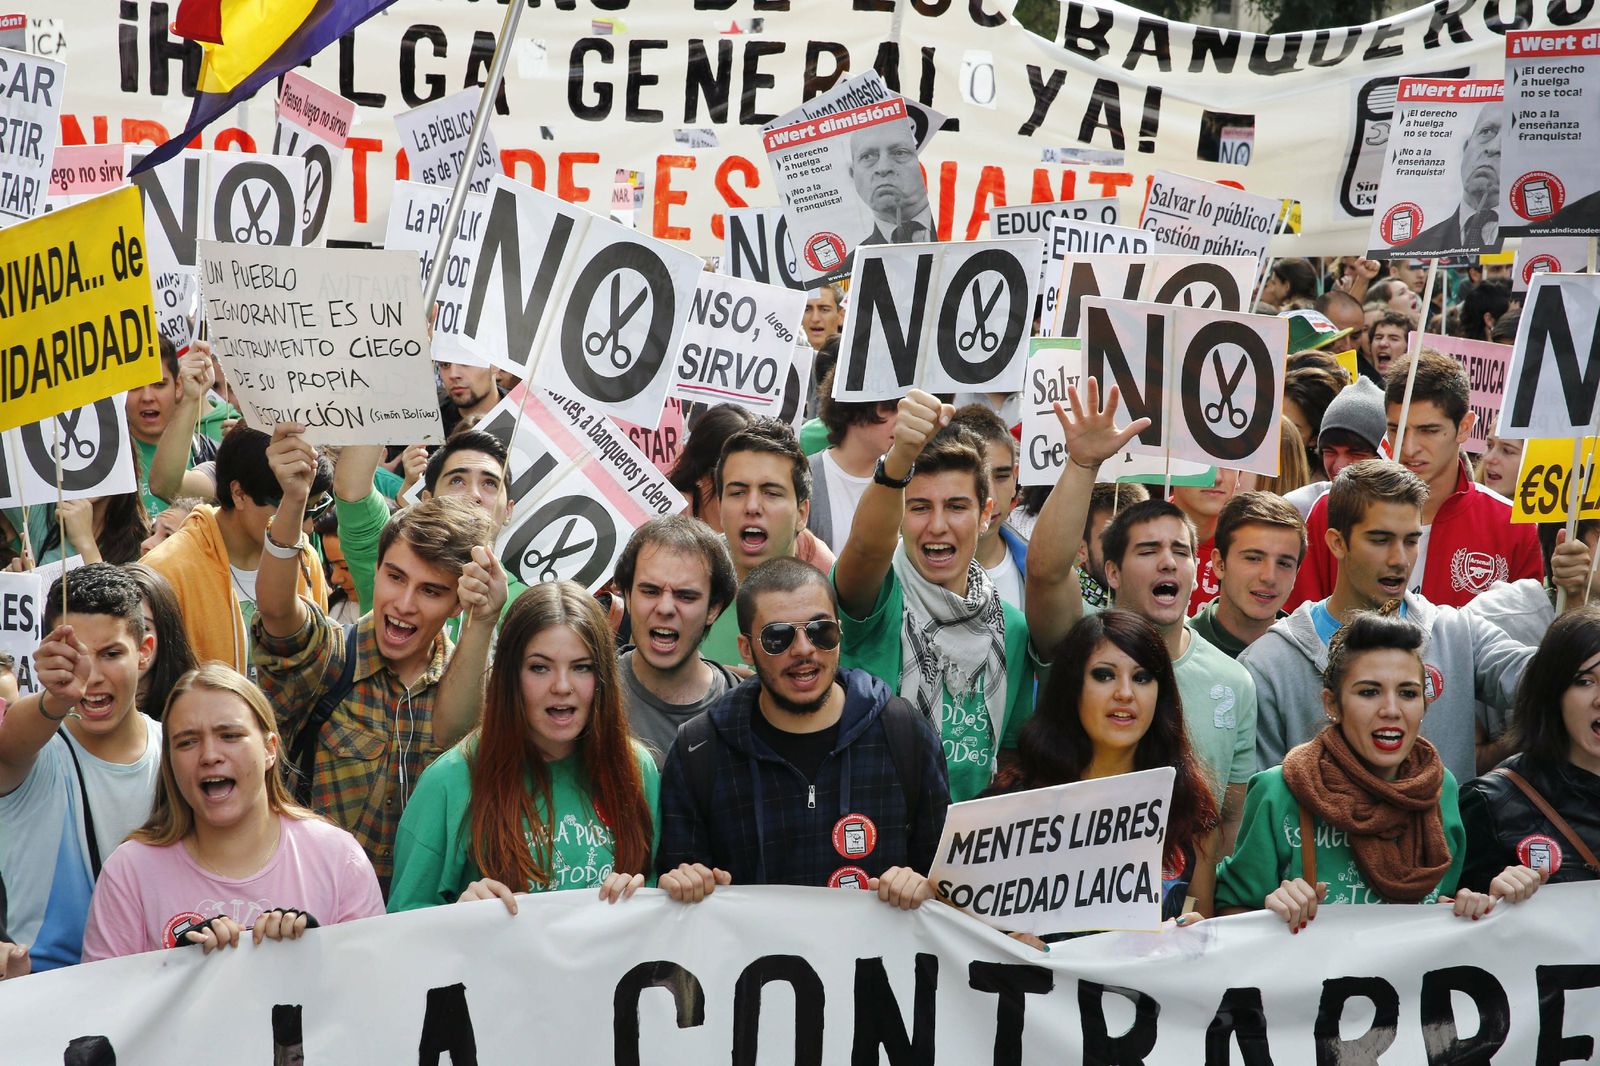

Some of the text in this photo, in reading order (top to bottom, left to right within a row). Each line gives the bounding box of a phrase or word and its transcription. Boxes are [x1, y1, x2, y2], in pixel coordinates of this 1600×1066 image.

[0, 16, 22, 27] ón!
[1513, 35, 1577, 54] ¡Wert
[118, 0, 510, 115] ¡HLGA
[1017, 64, 1163, 154] YA!
[1522, 65, 1585, 76] ¡El derecho
[1531, 77, 1570, 88] huelga
[1403, 83, 1456, 98] ¡Wert
[1554, 88, 1583, 97] toca!
[302, 94, 321, 127] luego
[320, 110, 331, 128] no
[1407, 109, 1458, 118] ¡El derecho
[1519, 110, 1538, 119] ¡No
[1549, 109, 1560, 118] la
[768, 125, 817, 149] ¡Wert
[818, 102, 901, 135] dimisión!
[1413, 120, 1444, 129] huelga
[1430, 130, 1453, 138] toca!
[1518, 120, 1580, 130] enseñanza
[1518, 131, 1582, 141] franquista!
[412, 129, 431, 152] La
[1399, 148, 1414, 156] ¡No
[1423, 148, 1432, 156] la
[422, 142, 497, 184] es de TOS,
[781, 146, 829, 163] ¡El derecho
[791, 157, 821, 170] huelga
[50, 168, 76, 191] ego
[79, 165, 97, 184] no
[786, 163, 832, 180] no se toca!
[1396, 168, 1446, 177] franquista!
[790, 188, 805, 197] ¡No
[813, 183, 822, 191] la
[131, 153, 296, 267] NO
[796, 196, 843, 214] franquista!
[1150, 183, 1197, 214] Salvar
[1196, 194, 1213, 218] lo
[1212, 201, 1276, 235] público!
[405, 197, 483, 242] La PÚLI
[112, 226, 144, 282] de
[204, 260, 223, 285] UN
[231, 260, 297, 291] PUEBLO
[440, 253, 471, 288] OD
[464, 187, 675, 404] NO
[209, 298, 403, 329] IGNORANTE ES UN
[846, 249, 1029, 392] NO
[764, 311, 794, 343] luego
[219, 336, 335, 359] INSTRUMENTO
[234, 368, 254, 390] DE
[260, 372, 275, 391] SU
[677, 343, 781, 397] SIRVO.
[1087, 306, 1275, 461] NO
[579, 414, 595, 430] a
[0, 395, 120, 498] O
[586, 417, 643, 482] banqueros
[620, 427, 678, 465] STAR
[627, 473, 650, 493] y
[1519, 463, 1600, 515] €SCL
[0, 593, 39, 641] ES,
[946, 798, 1165, 865] MENTES LIBRES,
[937, 861, 1159, 917] SOCIEDAD LAICA.
